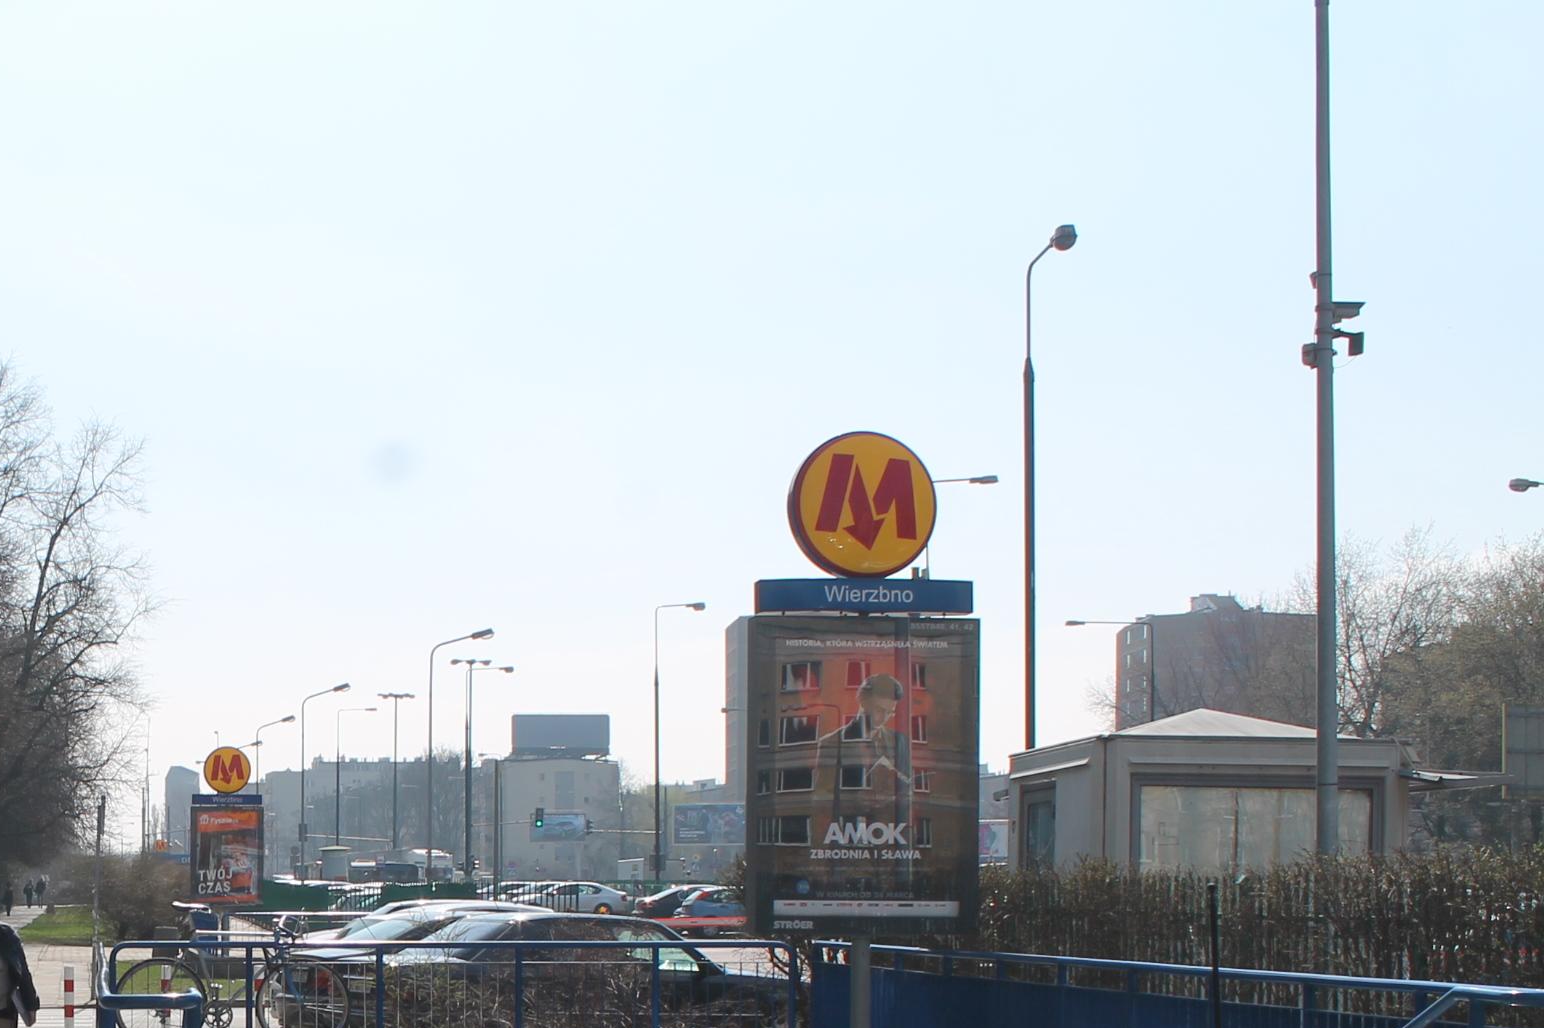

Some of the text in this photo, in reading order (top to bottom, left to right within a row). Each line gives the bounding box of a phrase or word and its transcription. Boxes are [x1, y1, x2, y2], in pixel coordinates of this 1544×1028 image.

[824, 585, 914, 603] Wierzbno
[786, 639, 824, 649] HISTORIA,
[826, 637, 853, 648] KTÓRA
[823, 822, 908, 845] AMOK
[810, 849, 921, 860] ZBRODNIA I SŁAWA
[199, 865, 233, 881] TWÓJ
[198, 882, 231, 895] CZAS
[773, 919, 814, 929] STRÖER
